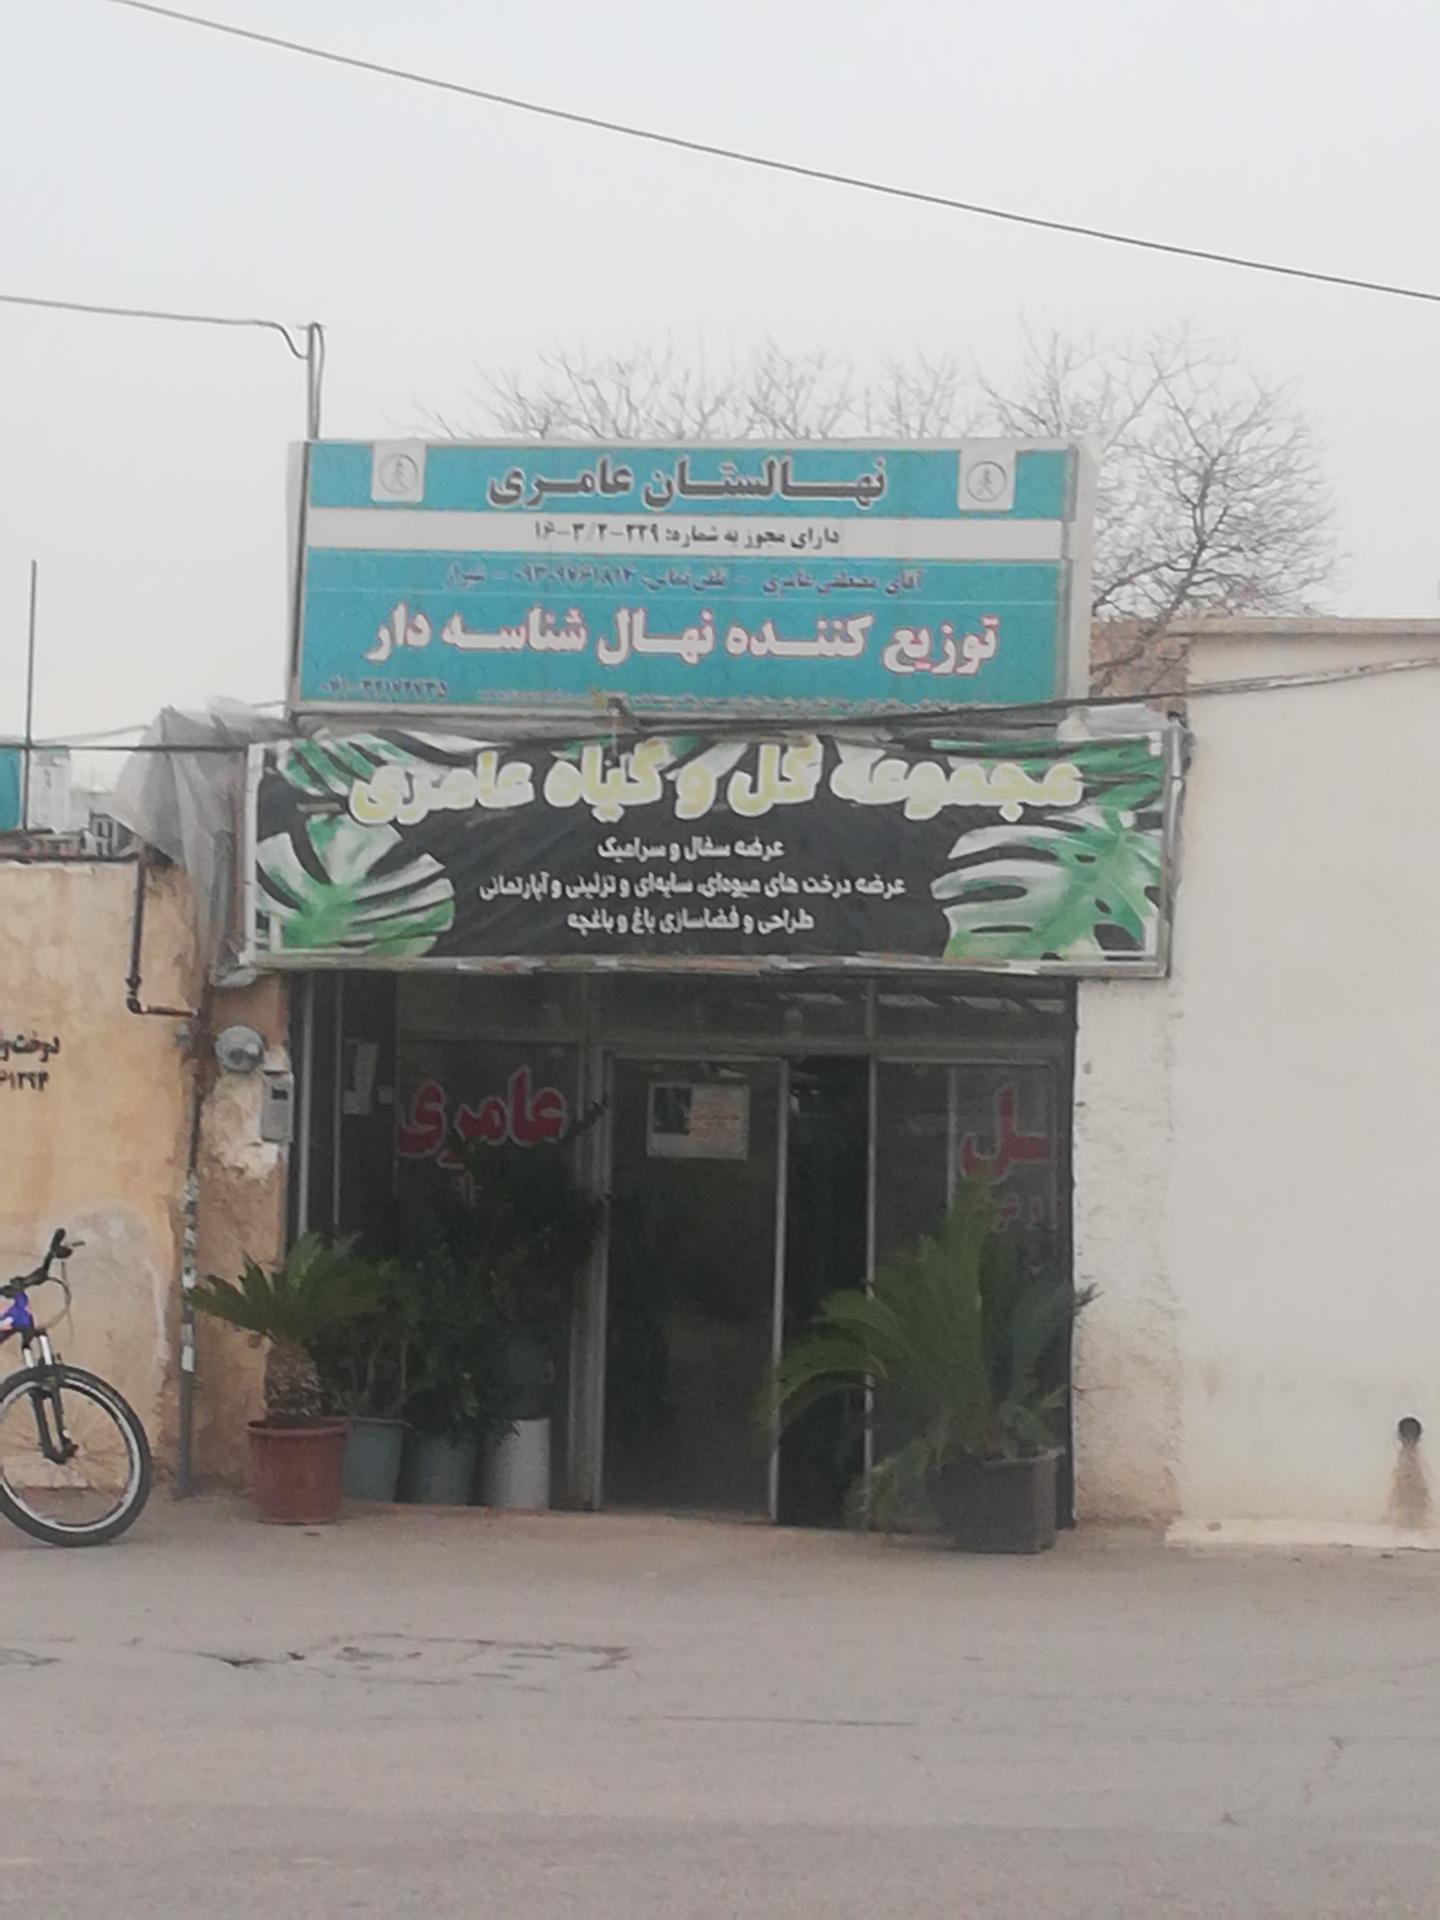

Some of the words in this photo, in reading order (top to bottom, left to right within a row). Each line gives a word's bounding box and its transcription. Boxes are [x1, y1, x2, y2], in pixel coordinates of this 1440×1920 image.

[487, 454, 635, 508] عامری
[642, 455, 888, 510] نهالستان
[724, 528, 739, 545] به
[744, 527, 785, 549] مجوز
[790, 526, 840, 549] دارای
[364, 602, 432, 665] دار
[441, 605, 589, 654] شناسه
[597, 606, 715, 667] نهال
[725, 613, 874, 659] کننده
[881, 615, 999, 676] توزیع
[349, 750, 535, 825] عامری
[543, 739, 671, 823] گیاه
[727, 734, 824, 817] گل
[674, 760, 716, 820] و
[829, 758, 1084, 822] مجموعه
[598, 836, 666, 863] سرامیک
[669, 842, 681, 863] و
[683, 836, 731, 861] سفال
[734, 837, 785, 862] عرضه
[480, 871, 549, 901] آپارتمانی
[551, 879, 562, 899] و
[619, 877, 631, 898] و
[764, 871, 799, 898] های
[802, 873, 852, 899] درخت
[855, 873, 906, 900] عرضه
[567, 907, 614, 937] باغچه
[616, 913, 628, 934] و
[632, 906, 655, 934] باغ
[659, 905, 740, 934] فضاسازی
[743, 913, 754, 935] و
[757, 908, 815, 935] طراحی
[393, 1064, 569, 1168] عامری
